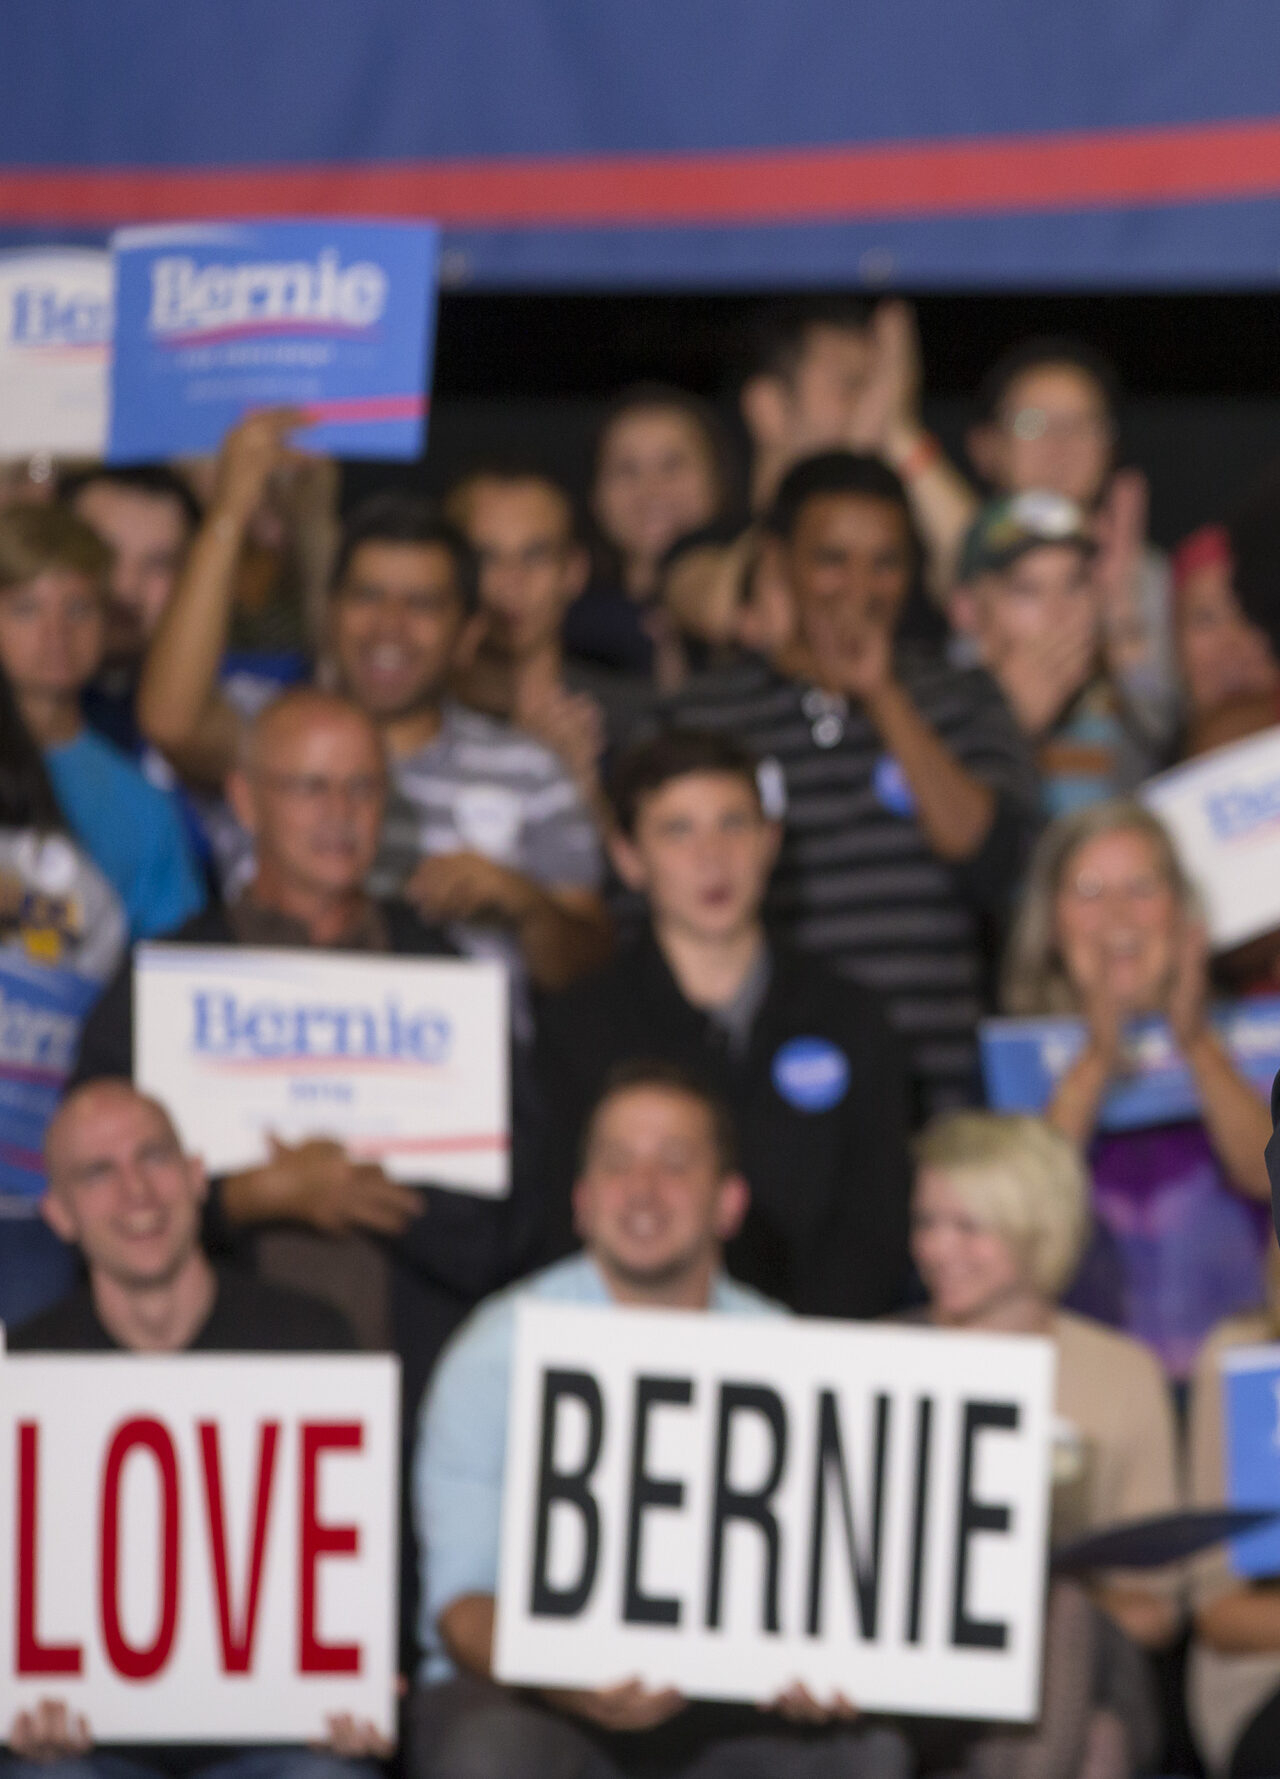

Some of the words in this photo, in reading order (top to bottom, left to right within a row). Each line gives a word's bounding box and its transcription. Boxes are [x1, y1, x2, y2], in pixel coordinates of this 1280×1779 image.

[149, 247, 388, 330] Bernie
[188, 986, 455, 1063] Bernie
[13, 1413, 366, 1681] LOVE
[528, 1366, 1021, 1652] BERNIE
